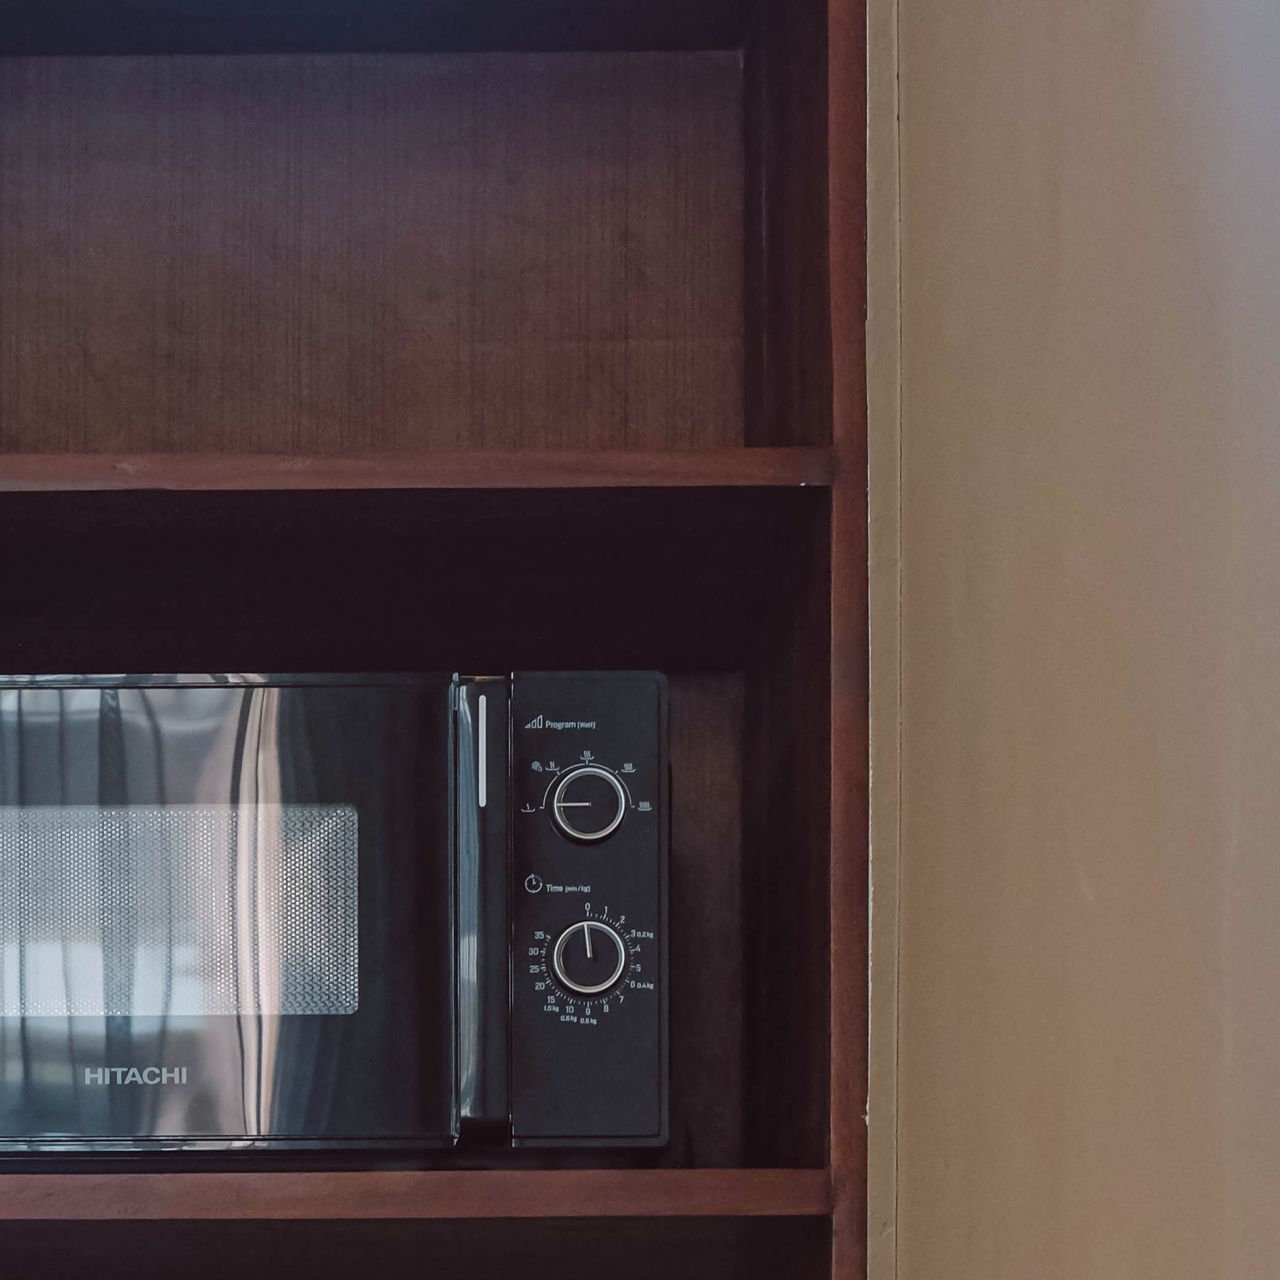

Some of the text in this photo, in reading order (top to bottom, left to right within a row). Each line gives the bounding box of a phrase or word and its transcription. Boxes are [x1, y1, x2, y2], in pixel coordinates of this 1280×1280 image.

[545, 720, 576, 730] Program
[546, 884, 563, 892] Time
[584, 902, 591, 911] 0
[620, 915, 625, 924] 2
[534, 931, 545, 939] 35
[528, 947, 539, 956] 30
[529, 965, 540, 974] 25
[534, 982, 546, 990] 20
[547, 995, 556, 1004] 15
[619, 995, 624, 1004] 7
[565, 1005, 575, 1014] 10
[84, 1066, 188, 1085] HITACHI
